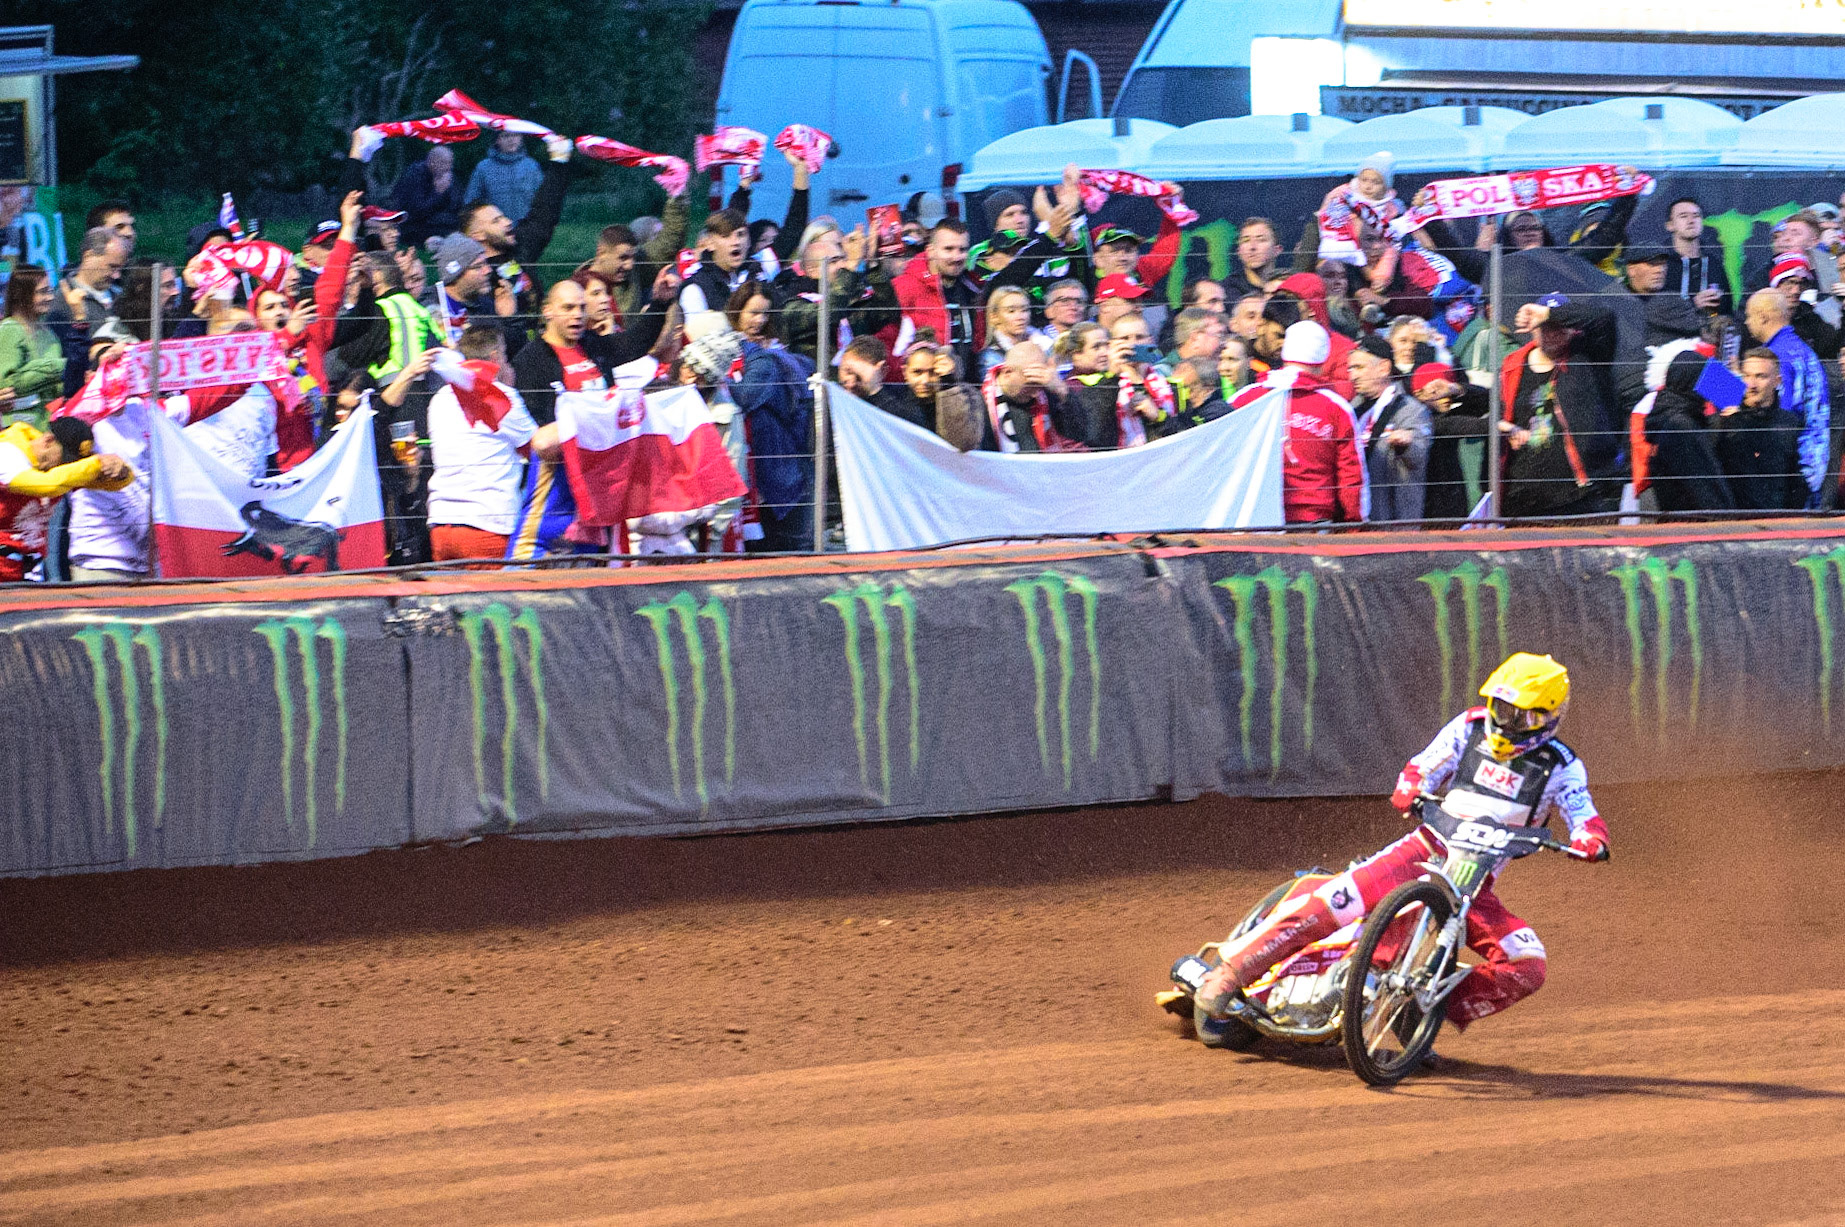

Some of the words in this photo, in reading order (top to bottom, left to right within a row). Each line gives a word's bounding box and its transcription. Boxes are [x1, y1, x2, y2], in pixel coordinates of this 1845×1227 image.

[1452, 186, 1506, 207] POL
[1543, 172, 1603, 197] SKA
[1481, 764, 1519, 789] NGK
